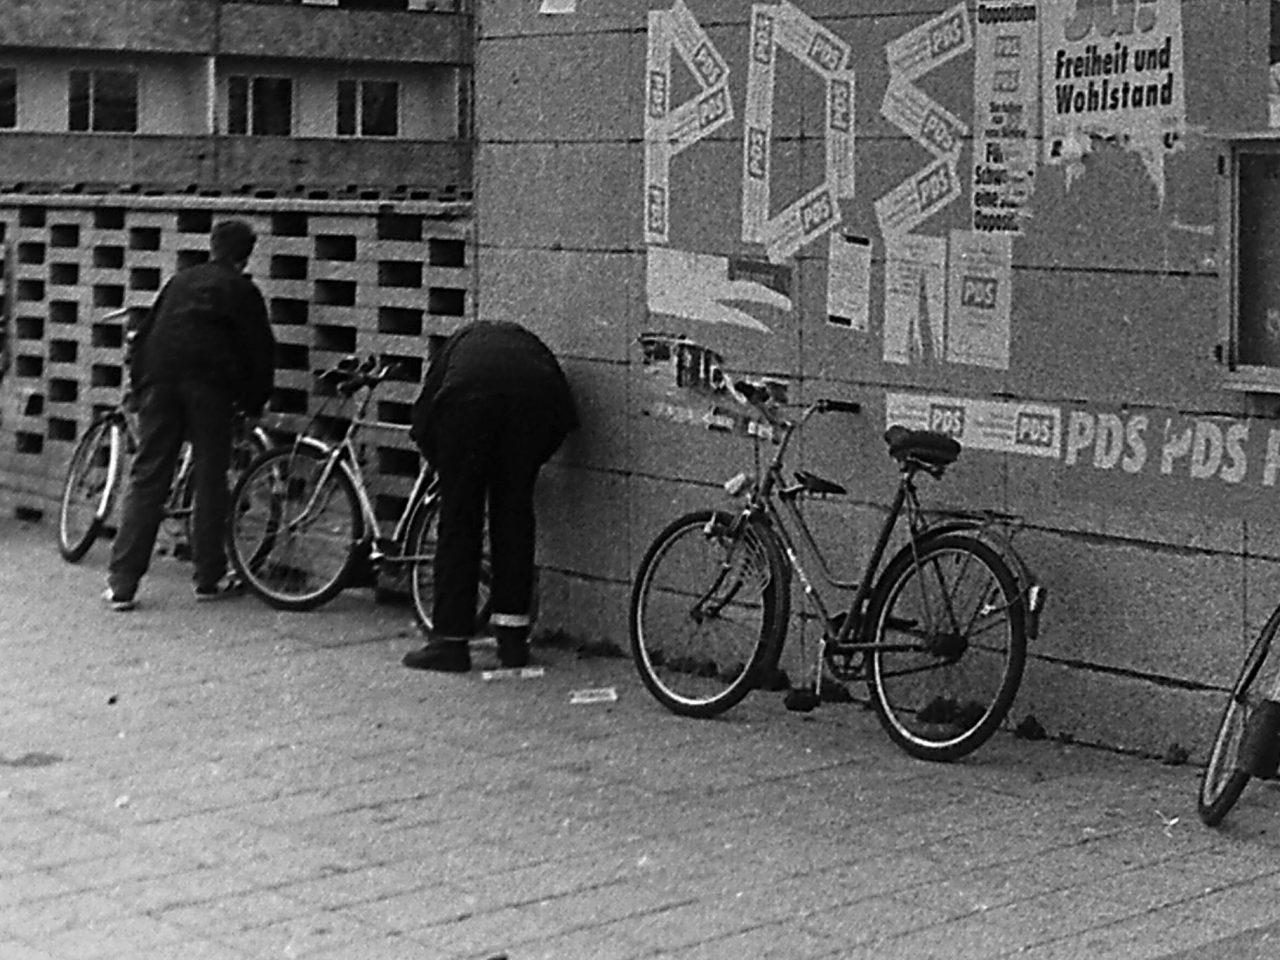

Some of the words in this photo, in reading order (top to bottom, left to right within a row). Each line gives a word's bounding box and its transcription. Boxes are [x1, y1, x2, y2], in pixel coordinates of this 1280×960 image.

[1055, 42, 1128, 79] Freiheit
[1134, 36, 1172, 72] und
[1055, 73, 1173, 114] Wohlstand
[963, 280, 996, 305] PDS
[932, 407, 963, 436] PDS
[1017, 416, 1051, 443] PDS
[1065, 410, 1149, 473] PDS
